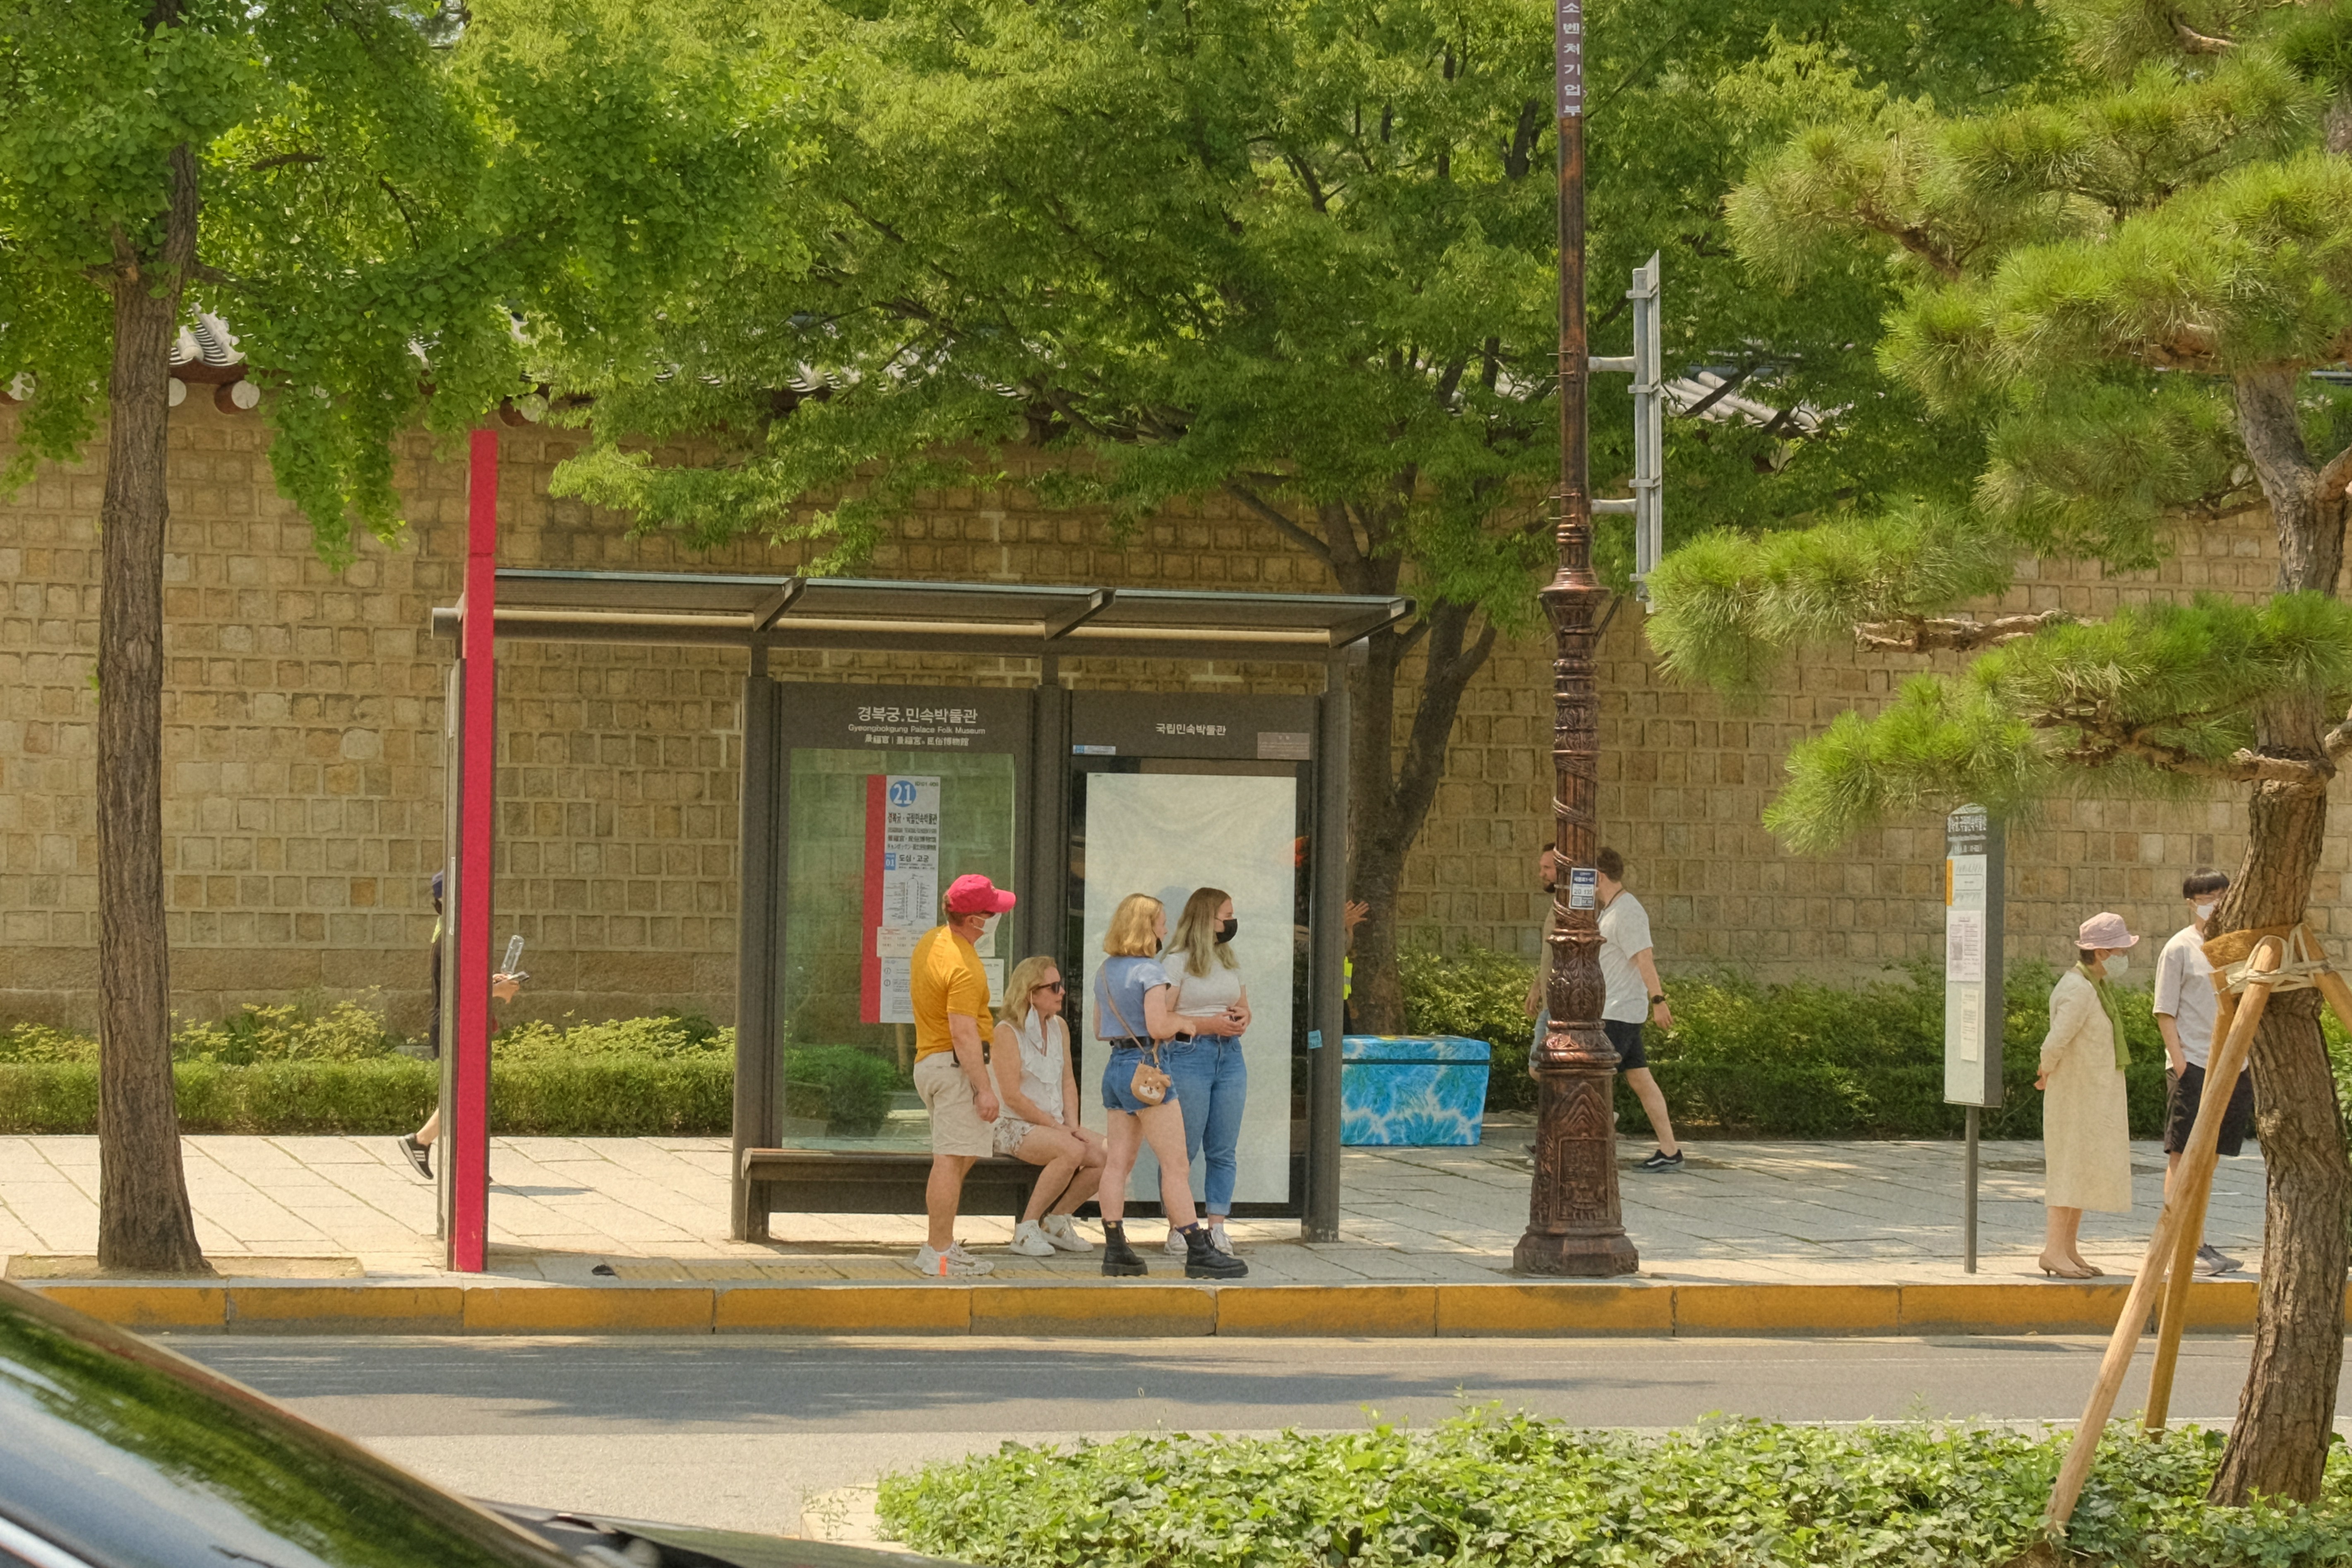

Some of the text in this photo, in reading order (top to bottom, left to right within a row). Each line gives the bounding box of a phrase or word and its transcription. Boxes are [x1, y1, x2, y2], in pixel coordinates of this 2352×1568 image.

[858, 706, 978, 724] 경복궁.민속박물관
[848, 724, 908, 733] Gyeongbokgung
[1155, 723, 1226, 735] 국립민속박물관
[894, 783, 912, 804] 21
